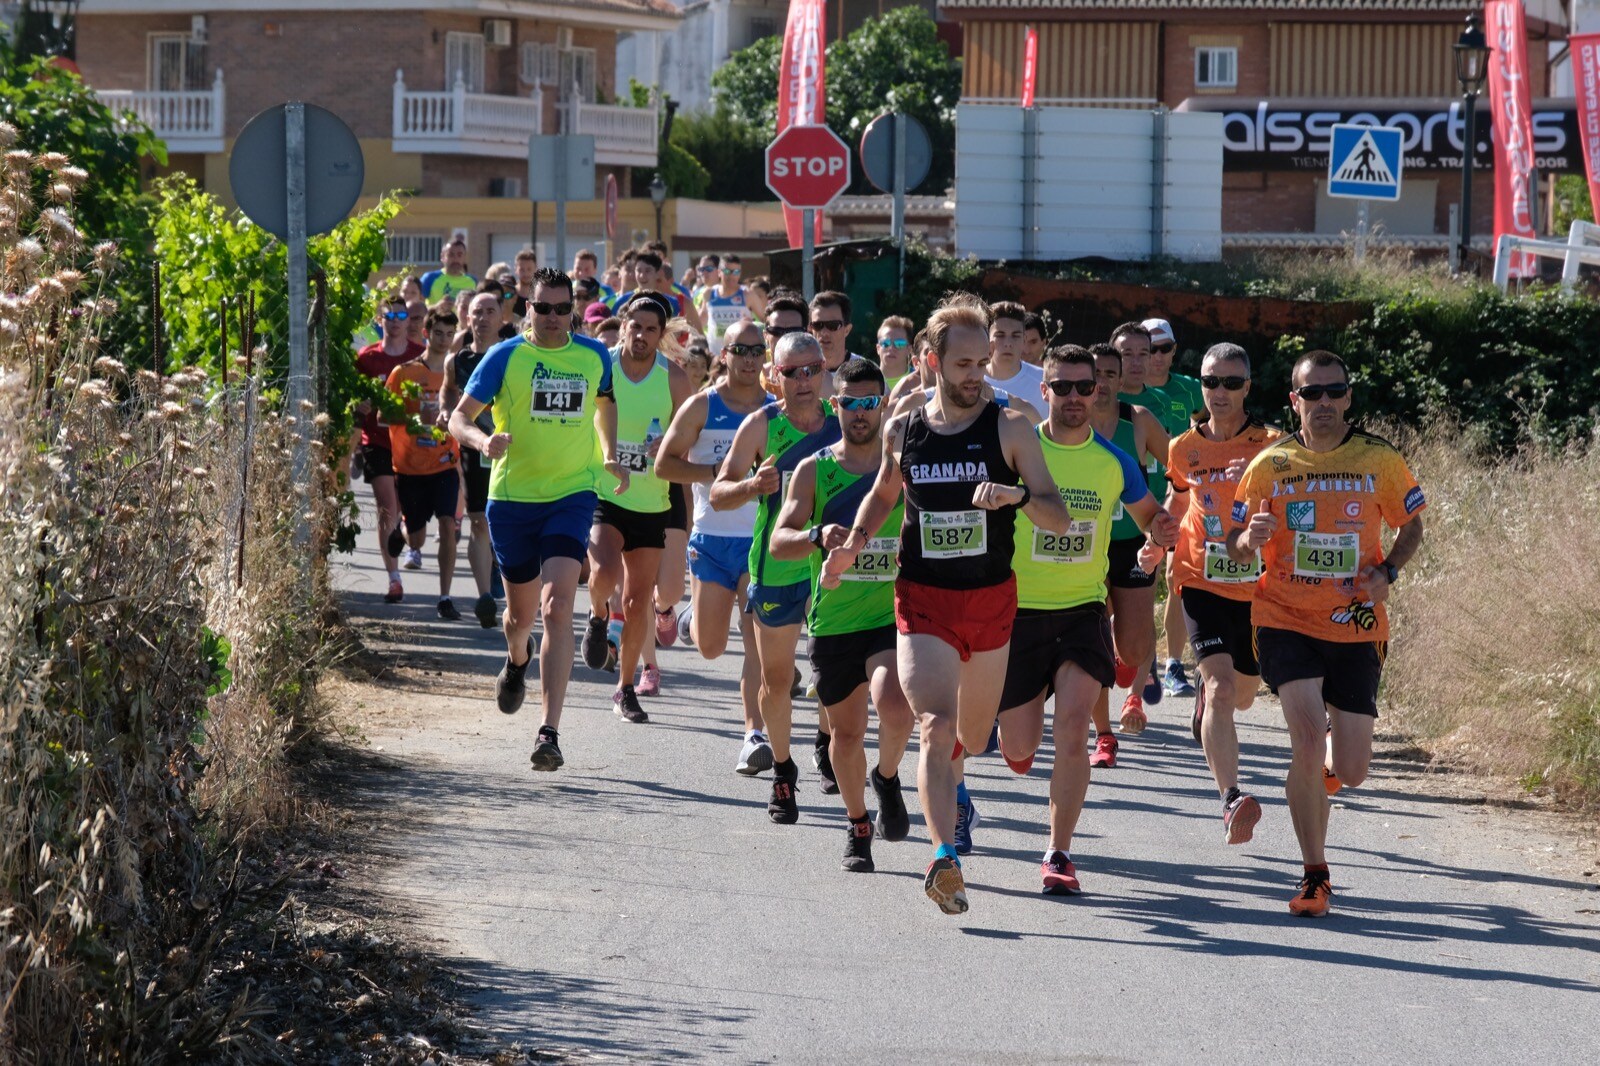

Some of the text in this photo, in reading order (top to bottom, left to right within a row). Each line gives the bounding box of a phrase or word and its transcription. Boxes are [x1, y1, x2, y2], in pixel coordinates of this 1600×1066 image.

[772, 156, 844, 177] STOP
[545, 392, 571, 408] 141
[910, 461, 988, 479] GRANADA
[1281, 471, 1363, 485] Club Deportivo
[1060, 487, 1098, 497] CARRERA
[1061, 494, 1102, 504] OLIDARIA
[1070, 502, 1102, 512] MUNDI
[931, 527, 974, 546] 587
[1043, 535, 1085, 552] 293
[852, 554, 889, 570] 424
[1213, 558, 1251, 574] 489
[1307, 549, 1344, 567] 431
